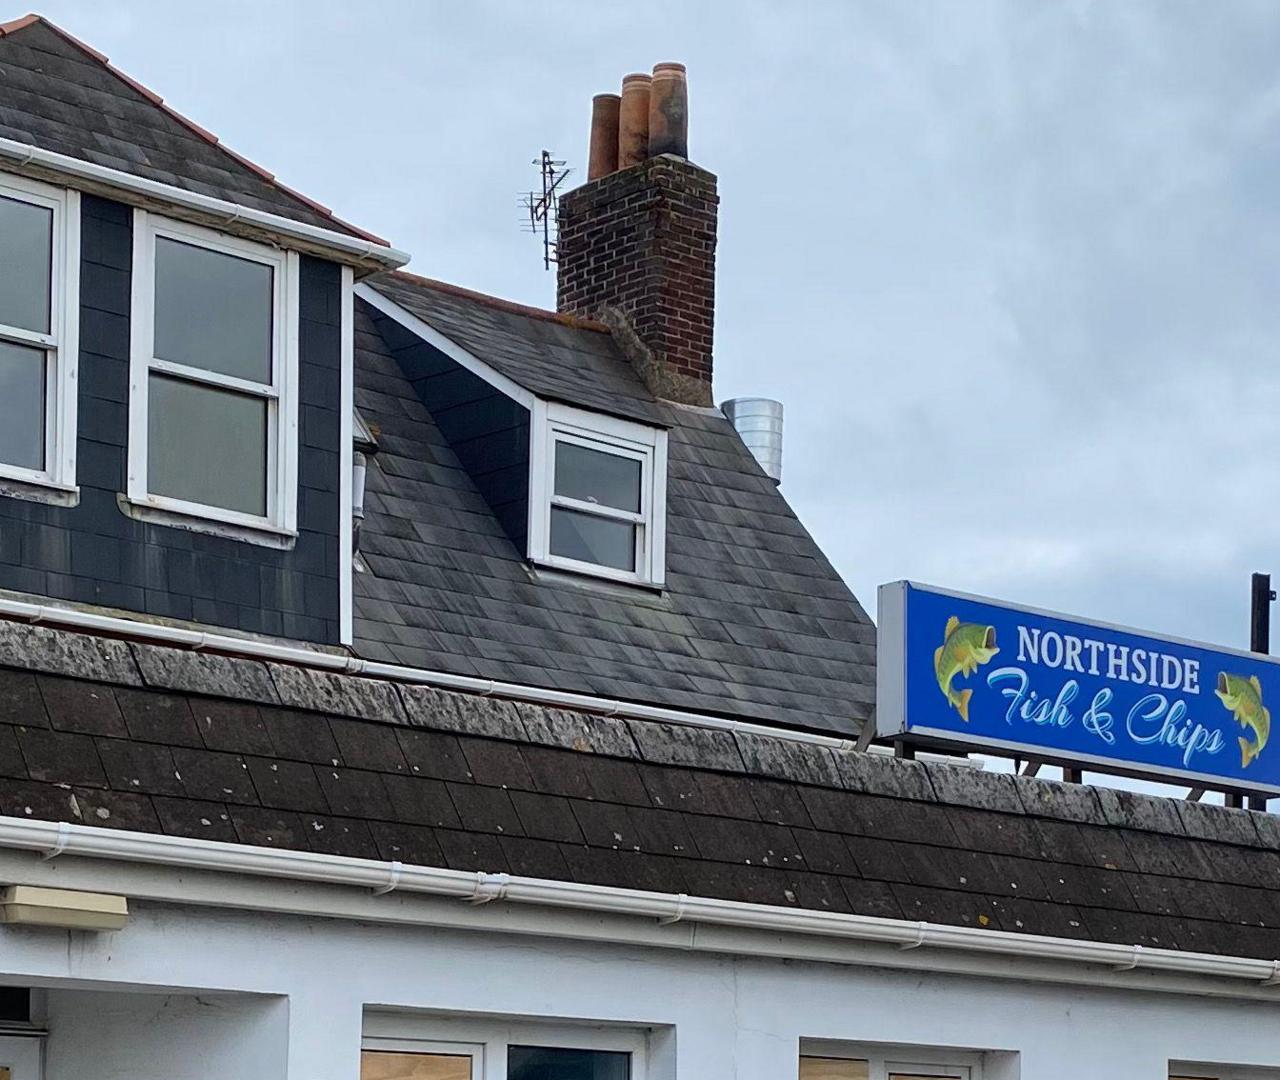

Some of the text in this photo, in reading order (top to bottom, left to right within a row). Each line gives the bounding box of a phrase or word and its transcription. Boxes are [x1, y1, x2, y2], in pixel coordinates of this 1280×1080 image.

[1017, 625, 1201, 695] NORTHSIDE
[987, 666, 1227, 769] Fish & Chips
